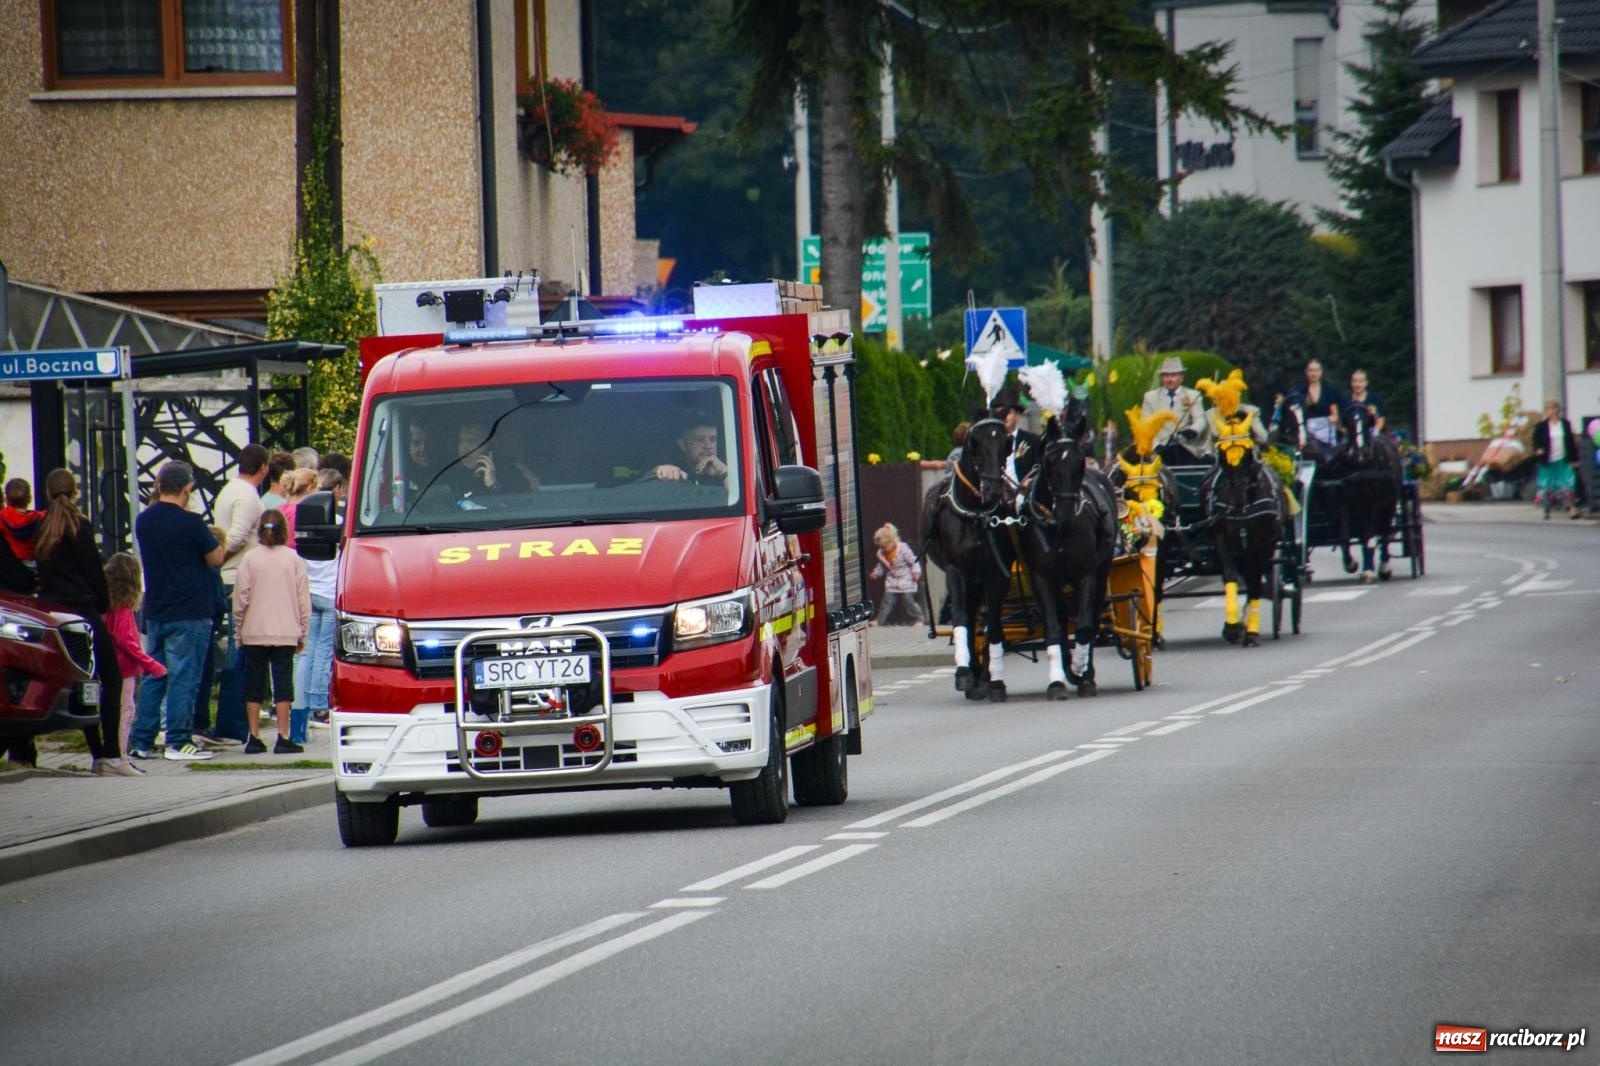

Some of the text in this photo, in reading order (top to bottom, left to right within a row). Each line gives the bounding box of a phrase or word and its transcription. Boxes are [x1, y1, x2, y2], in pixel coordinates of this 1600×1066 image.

[3, 358, 94, 374] ul.Boczna
[501, 639, 572, 656] MAN
[488, 658, 584, 681] SRC YT26
